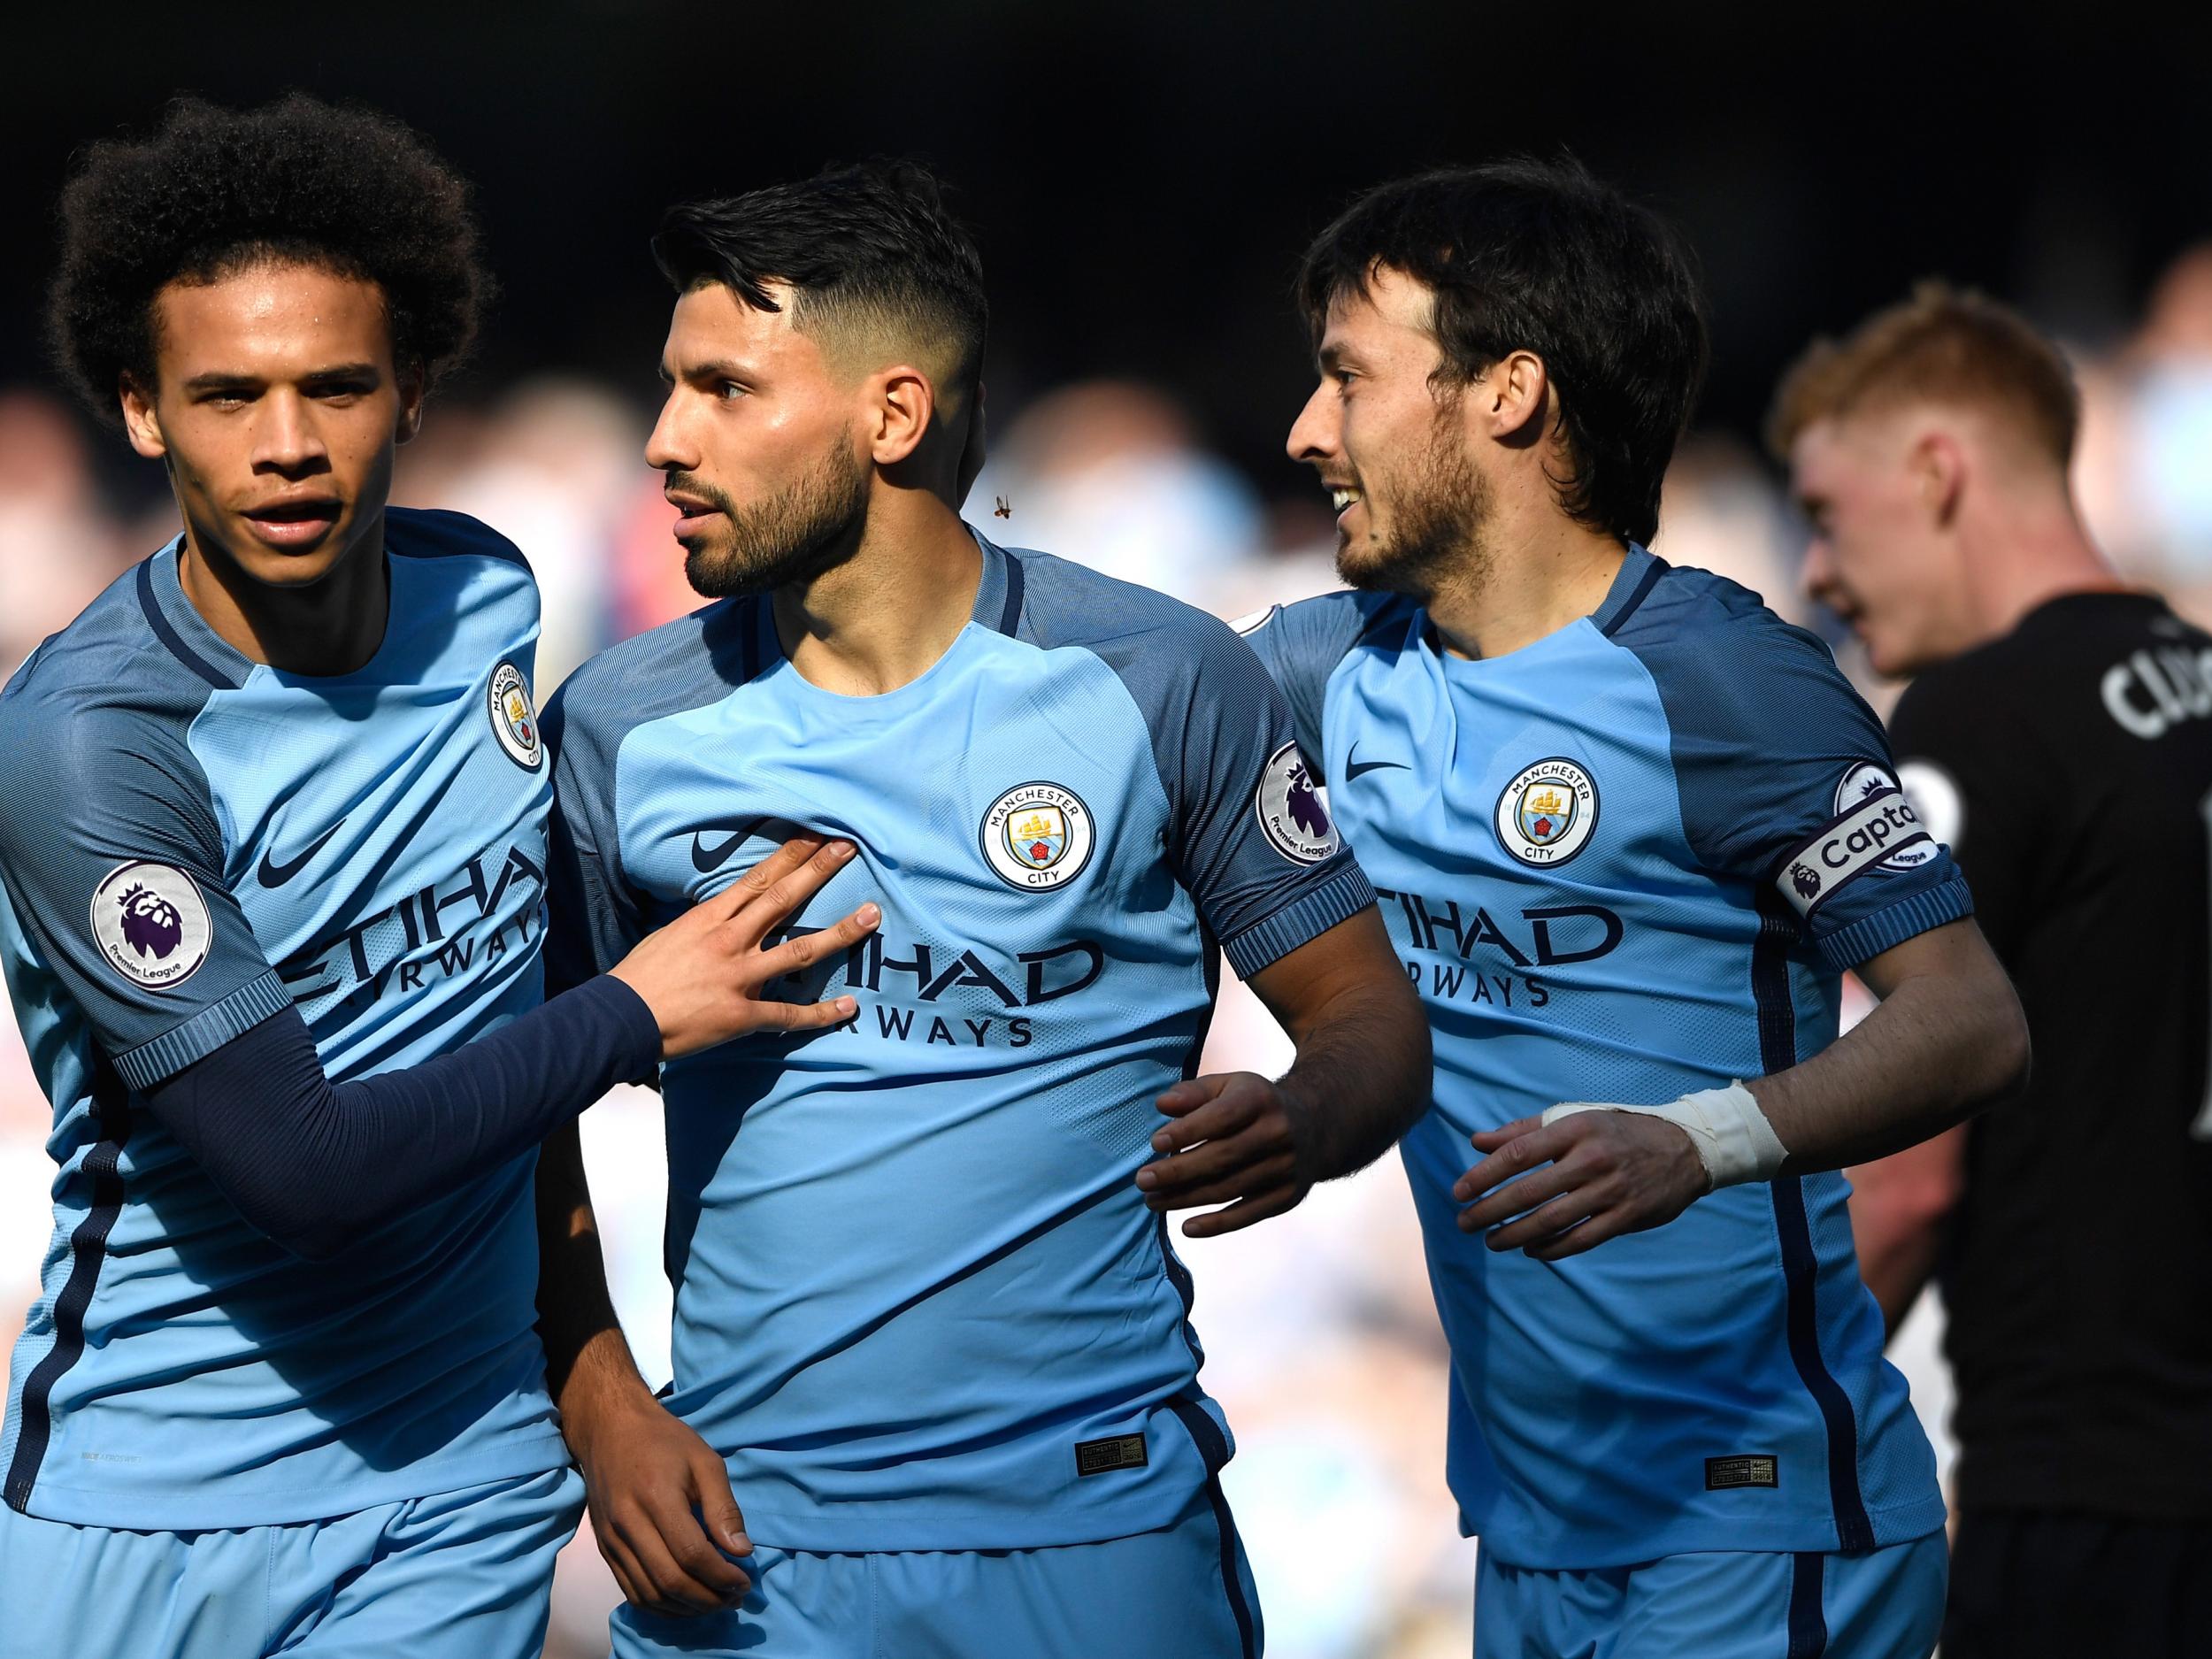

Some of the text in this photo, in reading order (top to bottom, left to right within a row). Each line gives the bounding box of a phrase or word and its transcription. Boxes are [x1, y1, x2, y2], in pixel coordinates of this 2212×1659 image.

[2100, 648, 2212, 740] CLU
[527, 749, 540, 764] CITY
[1511, 764, 1590, 802] MANCHESTER
[990, 788, 1079, 827] MANCHESTER
[1271, 815, 1298, 849] Premier
[1821, 803, 1922, 869] Capta
[1524, 847, 1555, 860] CITY
[1892, 851, 1927, 864] League
[1027, 870, 1060, 884] CITY
[280, 823, 547, 1005] ETIHA
[1375, 887, 1624, 967] IHAD
[109, 943, 181, 979] Premier League
[1407, 961, 1549, 1008] RWAYS
